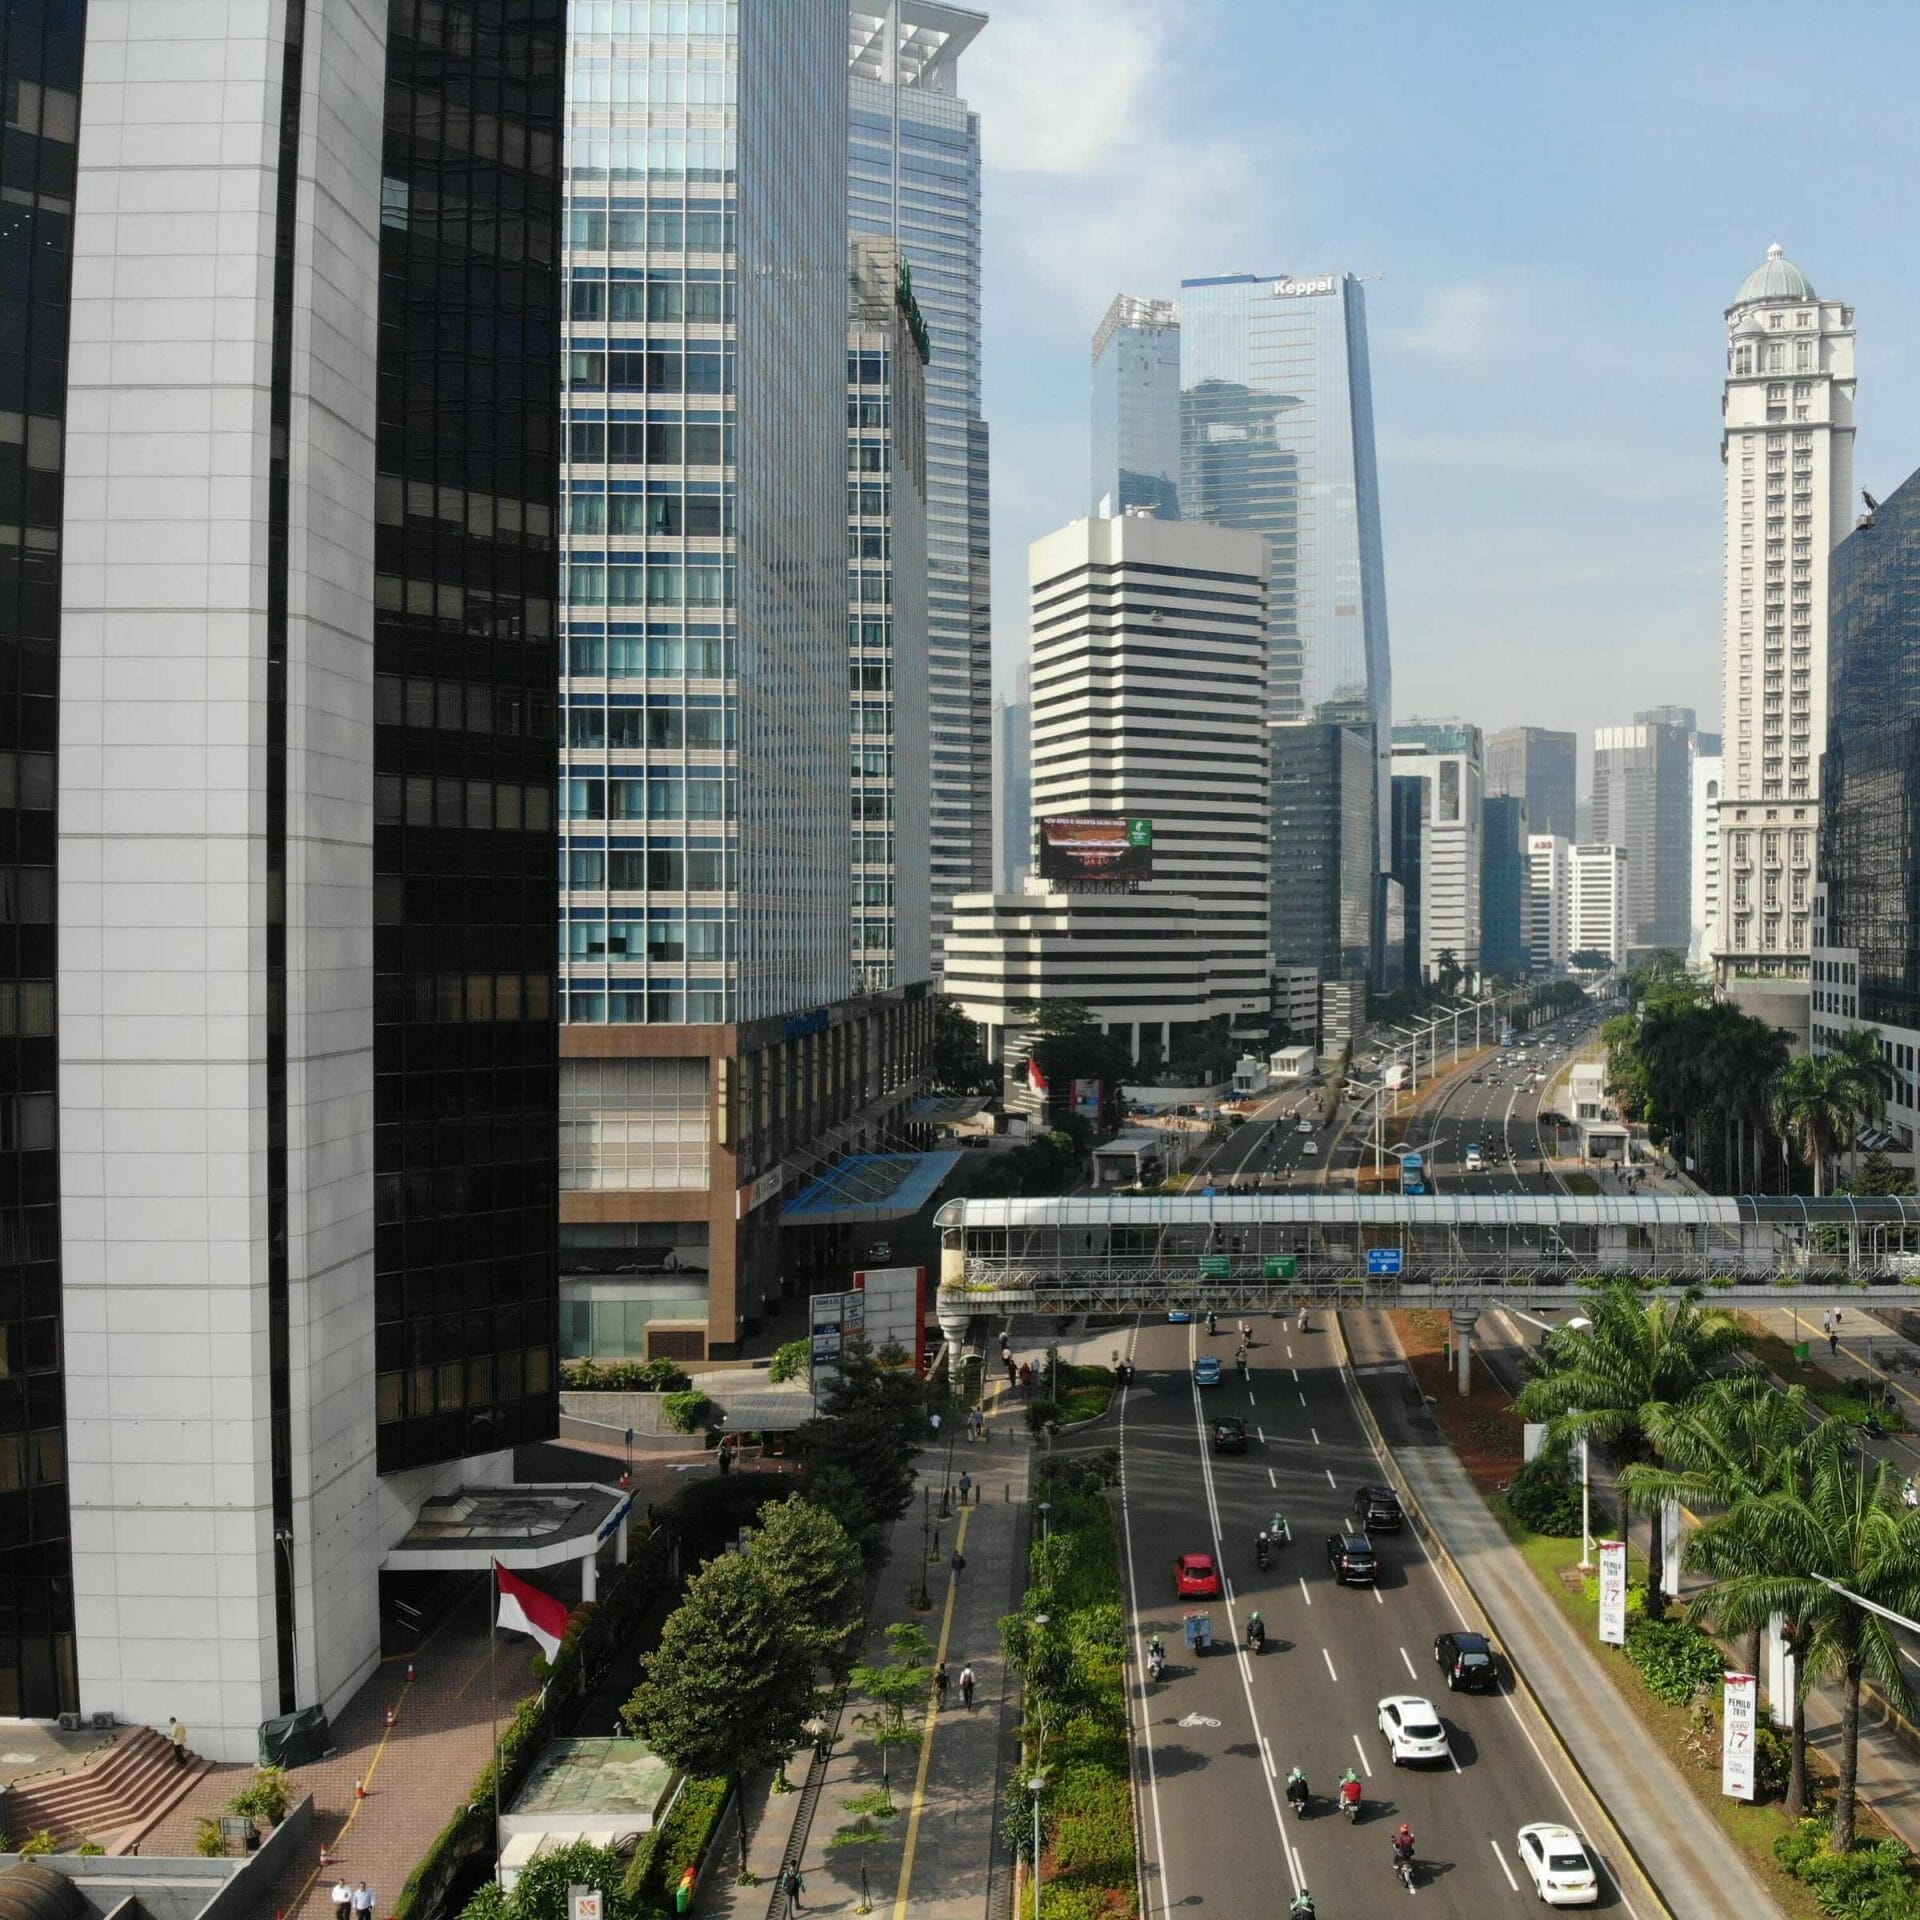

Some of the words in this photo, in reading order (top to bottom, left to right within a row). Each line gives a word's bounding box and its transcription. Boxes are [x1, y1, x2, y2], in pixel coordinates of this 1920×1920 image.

[1275, 277, 1332, 295] Keppel
[1605, 1588, 1620, 1602] 17
[1728, 1698, 1751, 1709] PEMILU
[1732, 1708, 1747, 1717] 2019
[1729, 1731, 1749, 1748] 17
